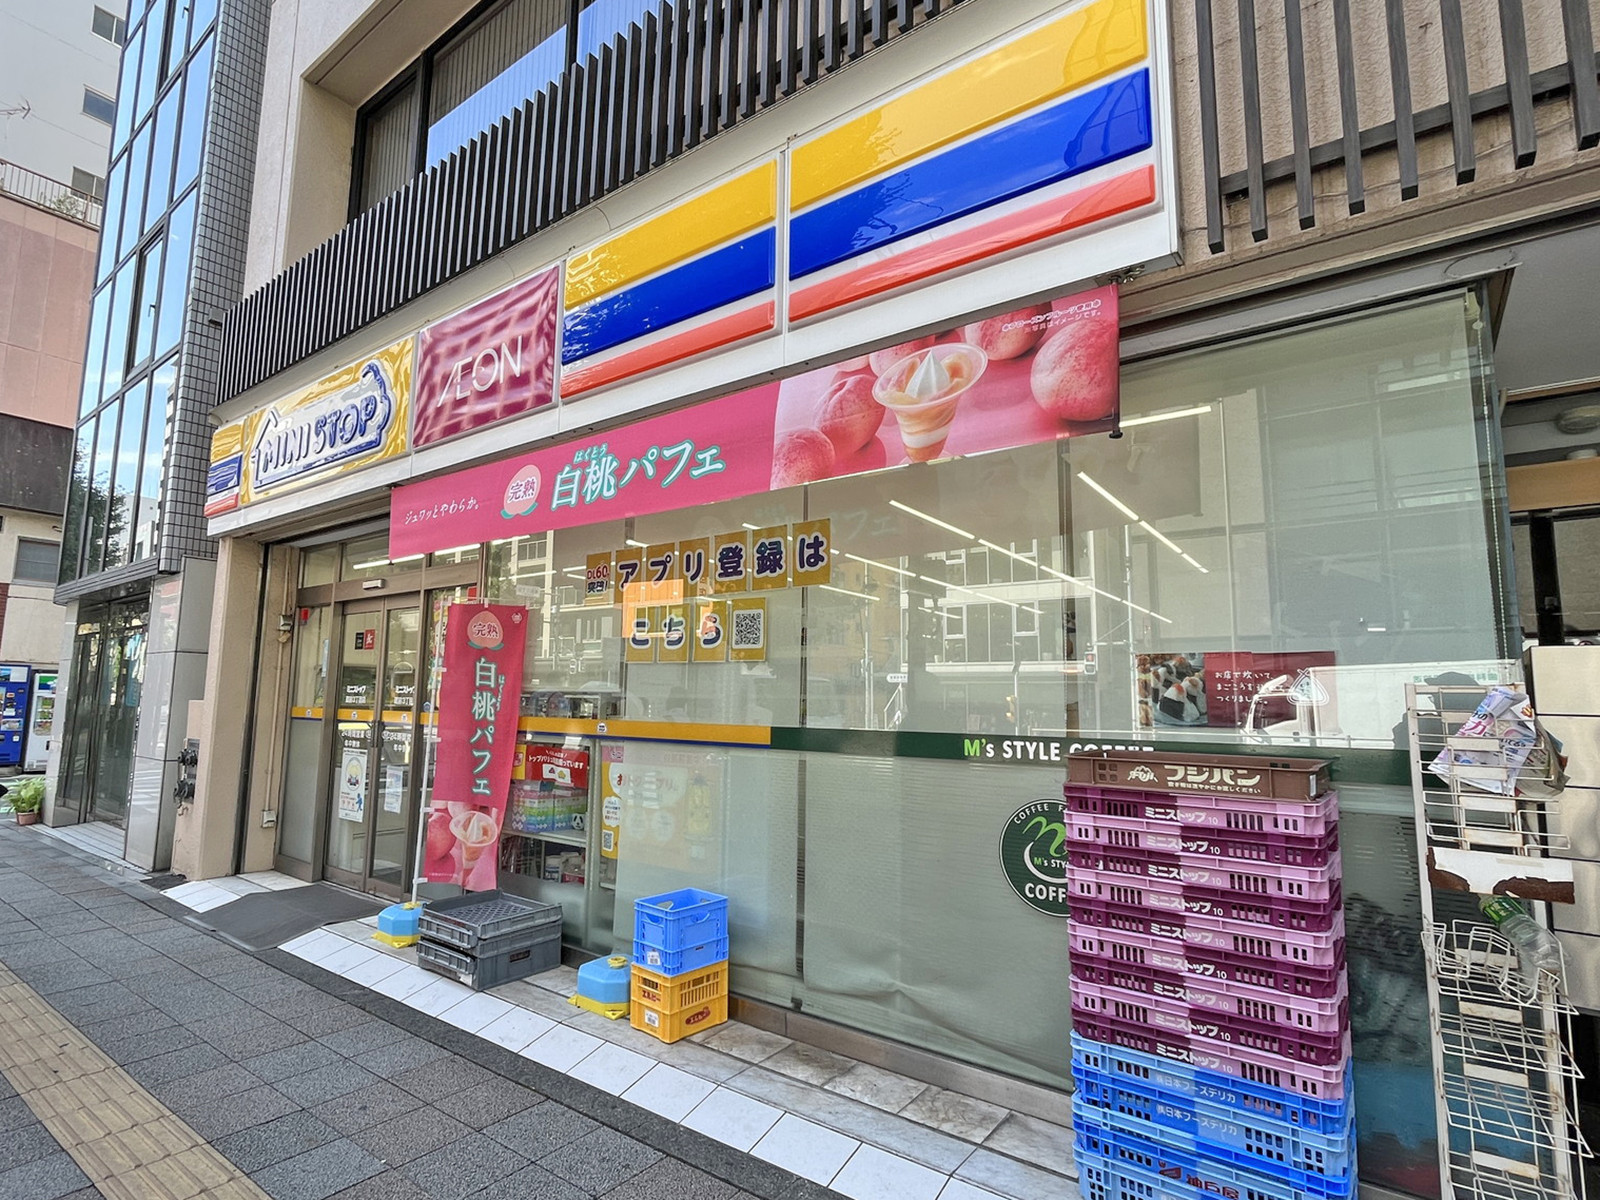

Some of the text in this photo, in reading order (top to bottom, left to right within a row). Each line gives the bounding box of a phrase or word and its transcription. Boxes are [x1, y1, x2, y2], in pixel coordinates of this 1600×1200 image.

[551, 440, 727, 511] 白桃パフェ
[509, 477, 537, 503] 完熟
[404, 496, 481, 526] ジュワッとやわらか。
[618, 533, 826, 591] アプリ登録は
[473, 622, 500, 638] 完熟
[470, 657, 497, 796] 白桃パフェ
[964, 739, 995, 758] M's
[1002, 741, 1060, 761] STYLE
[1164, 765, 1261, 786] フジパン
[1013, 804, 1049, 824] COFFEE
[1145, 806, 1219, 825] ミニストップ 10
[1147, 835, 1221, 855] ミニストップ 10
[1034, 857, 1068, 868] M's STY
[1148, 864, 1222, 886] ミニストップ 10
[1024, 883, 1067, 903] COFF
[1149, 894, 1224, 917] ミニストップ 10
[1150, 923, 1226, 947] ミニストップ 10
[1152, 953, 1228, 980] ミニストップ 10
[1153, 982, 1229, 1010] ミニストップ 10
[1155, 1013, 1231, 1042] ミニストップ 10
[1156, 1043, 1233, 1074] ミニストップ 10
